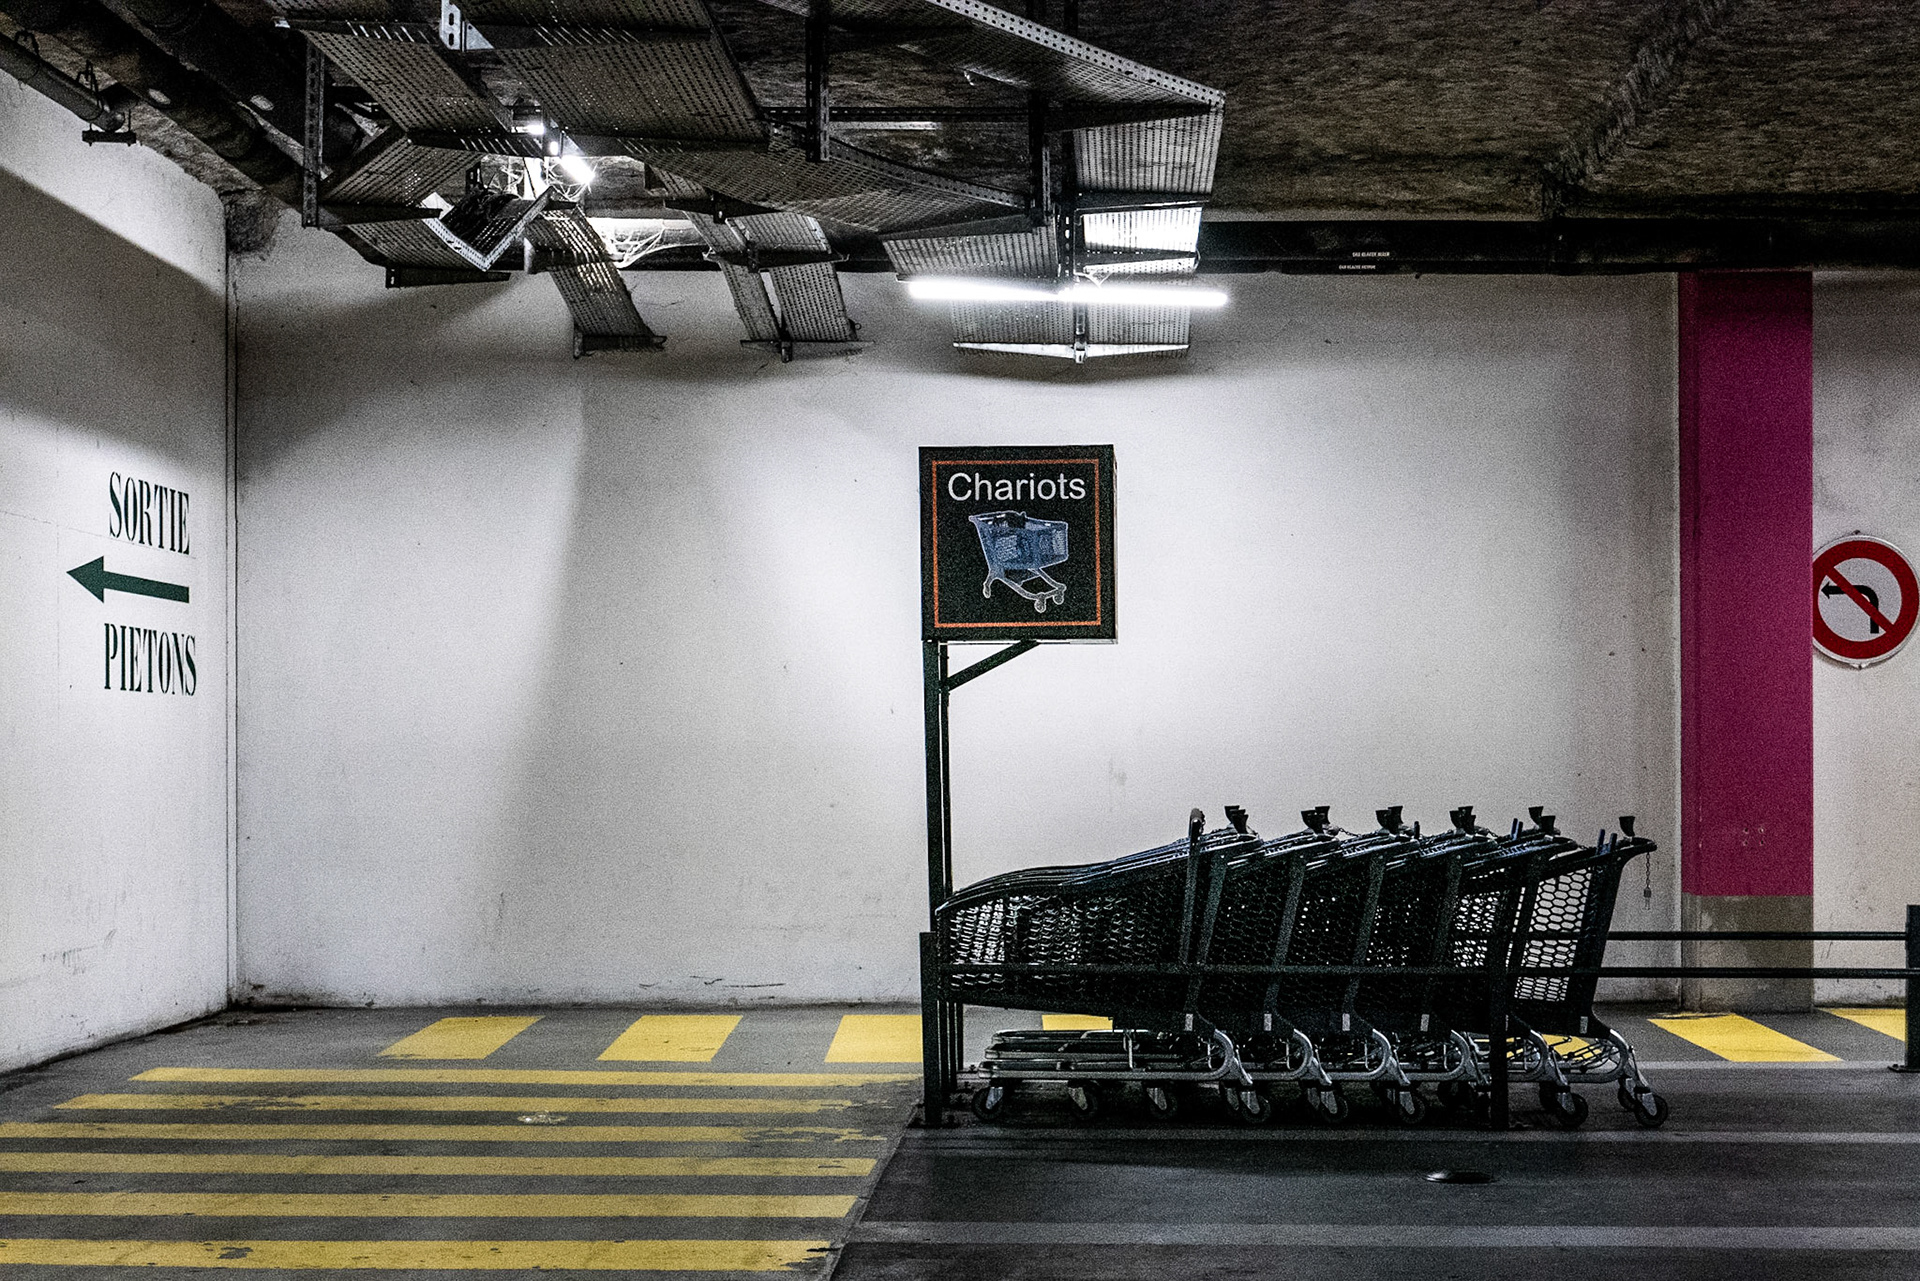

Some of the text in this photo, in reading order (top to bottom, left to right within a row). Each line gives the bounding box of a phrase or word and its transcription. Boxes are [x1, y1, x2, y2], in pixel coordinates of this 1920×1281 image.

[109, 471, 190, 555] SORTIE
[948, 472, 1086, 501] Chariots
[104, 622, 197, 696] PIETONS
